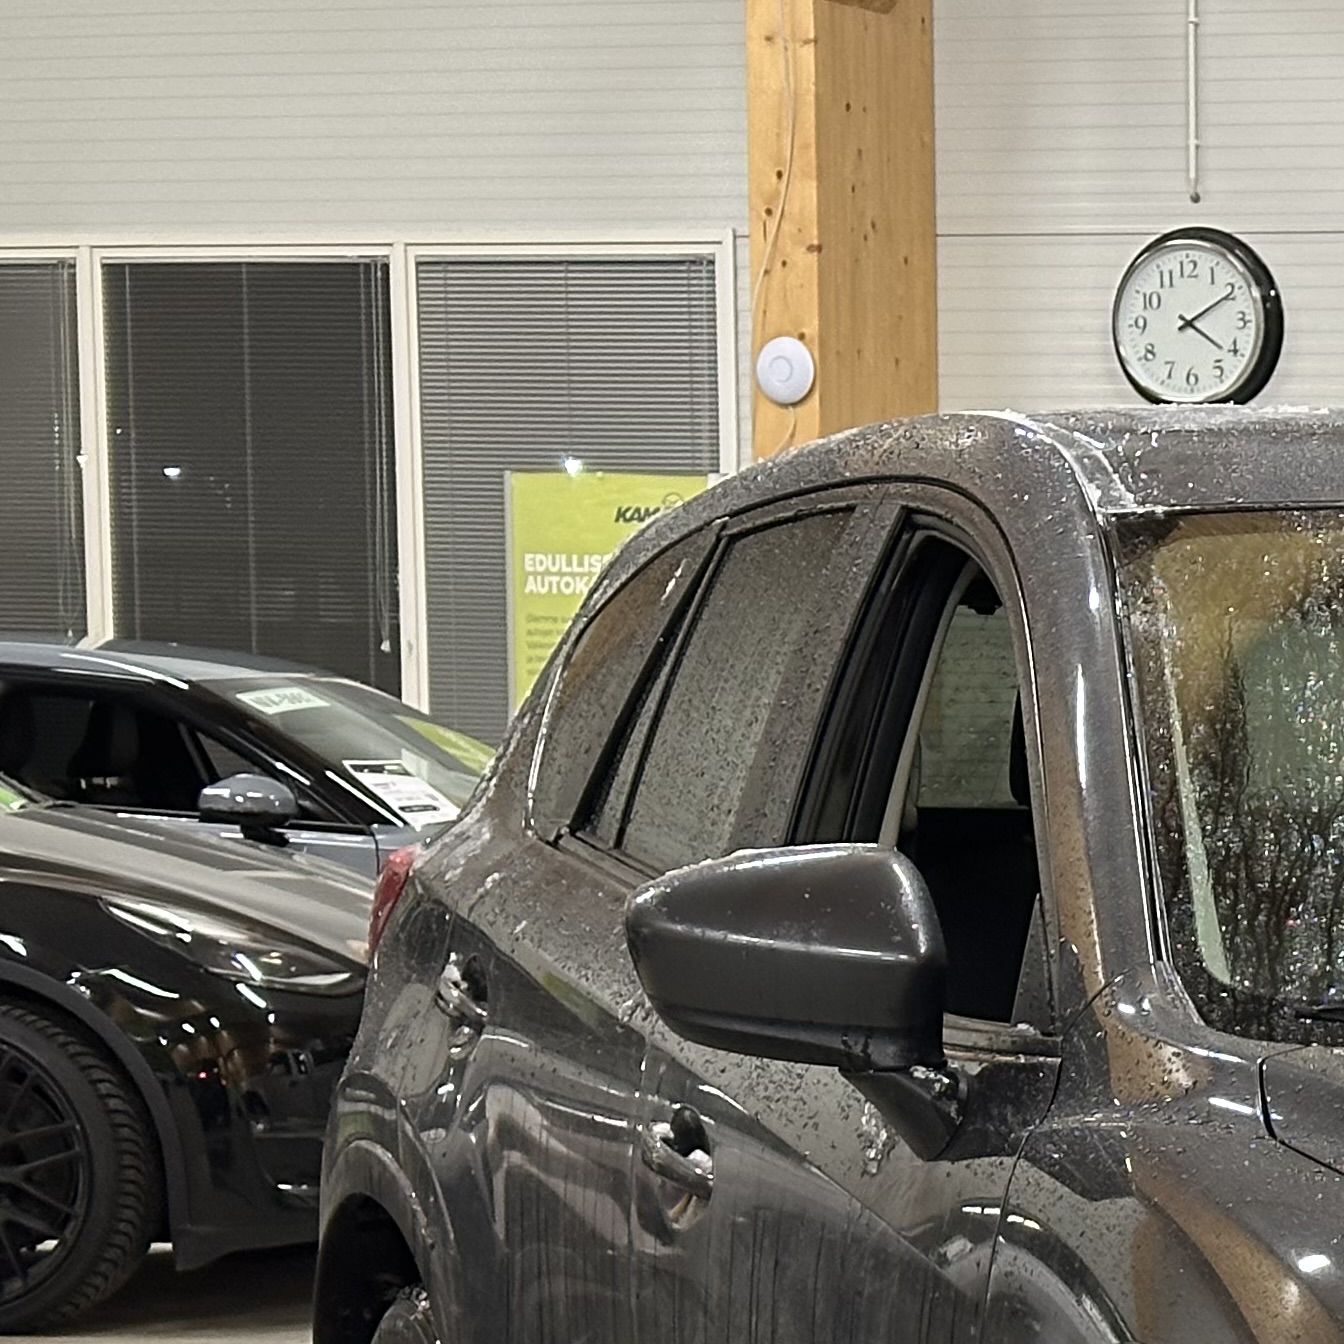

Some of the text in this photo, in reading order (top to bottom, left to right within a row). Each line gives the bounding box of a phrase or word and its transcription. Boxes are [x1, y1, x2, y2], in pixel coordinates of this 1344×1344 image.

[1159, 269, 1174, 289] 11
[1179, 260, 1199, 279] 12
[1142, 291, 1161, 311] 10
[1225, 282, 1236, 301] 2
[1134, 315, 1147, 335] 9
[1236, 310, 1248, 330] 3
[1144, 343, 1156, 362] 8
[1227, 337, 1239, 357] 4
[1164, 360, 1176, 380] 7
[1185, 366, 1199, 386] 6
[1212, 359, 1224, 379] 5
[524, 575, 597, 595] AUTOK
